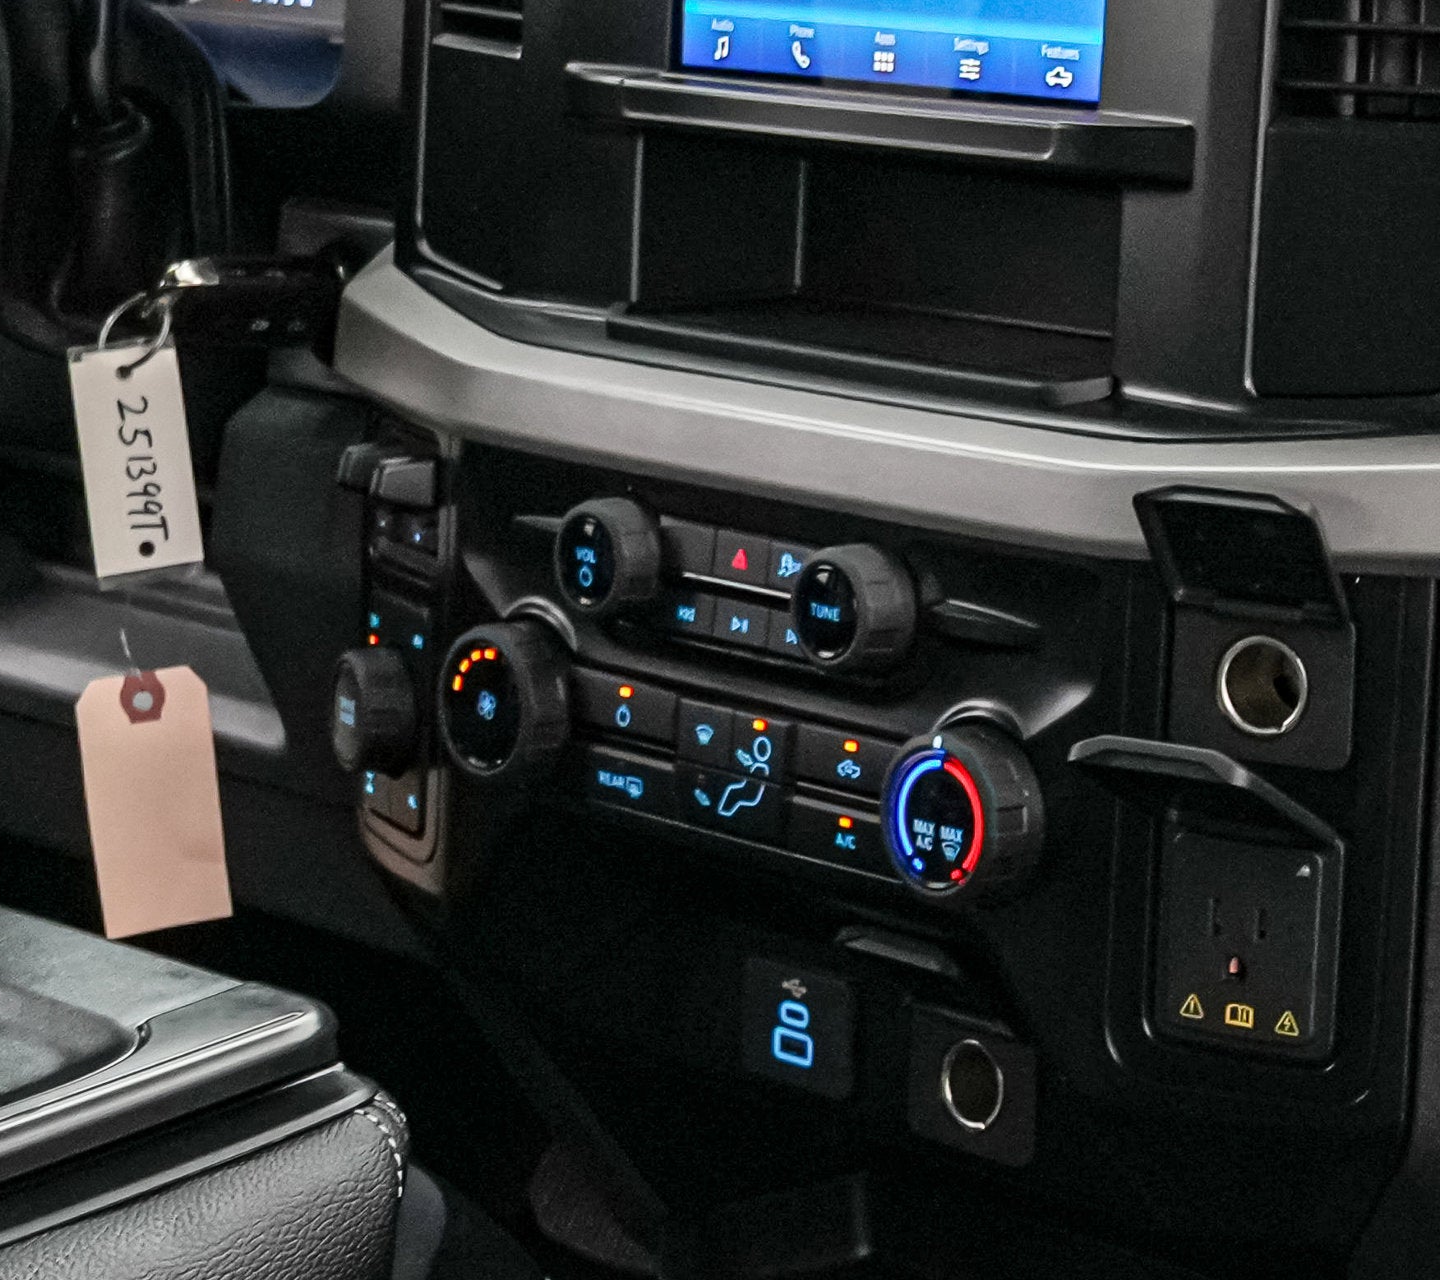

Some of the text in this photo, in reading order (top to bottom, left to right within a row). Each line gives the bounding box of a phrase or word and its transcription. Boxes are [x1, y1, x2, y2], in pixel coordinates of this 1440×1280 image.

[116, 395, 170, 541] 251399T
[575, 546, 596, 564] VOL
[810, 602, 841, 622] TUNE
[834, 832, 857, 850] A/C
